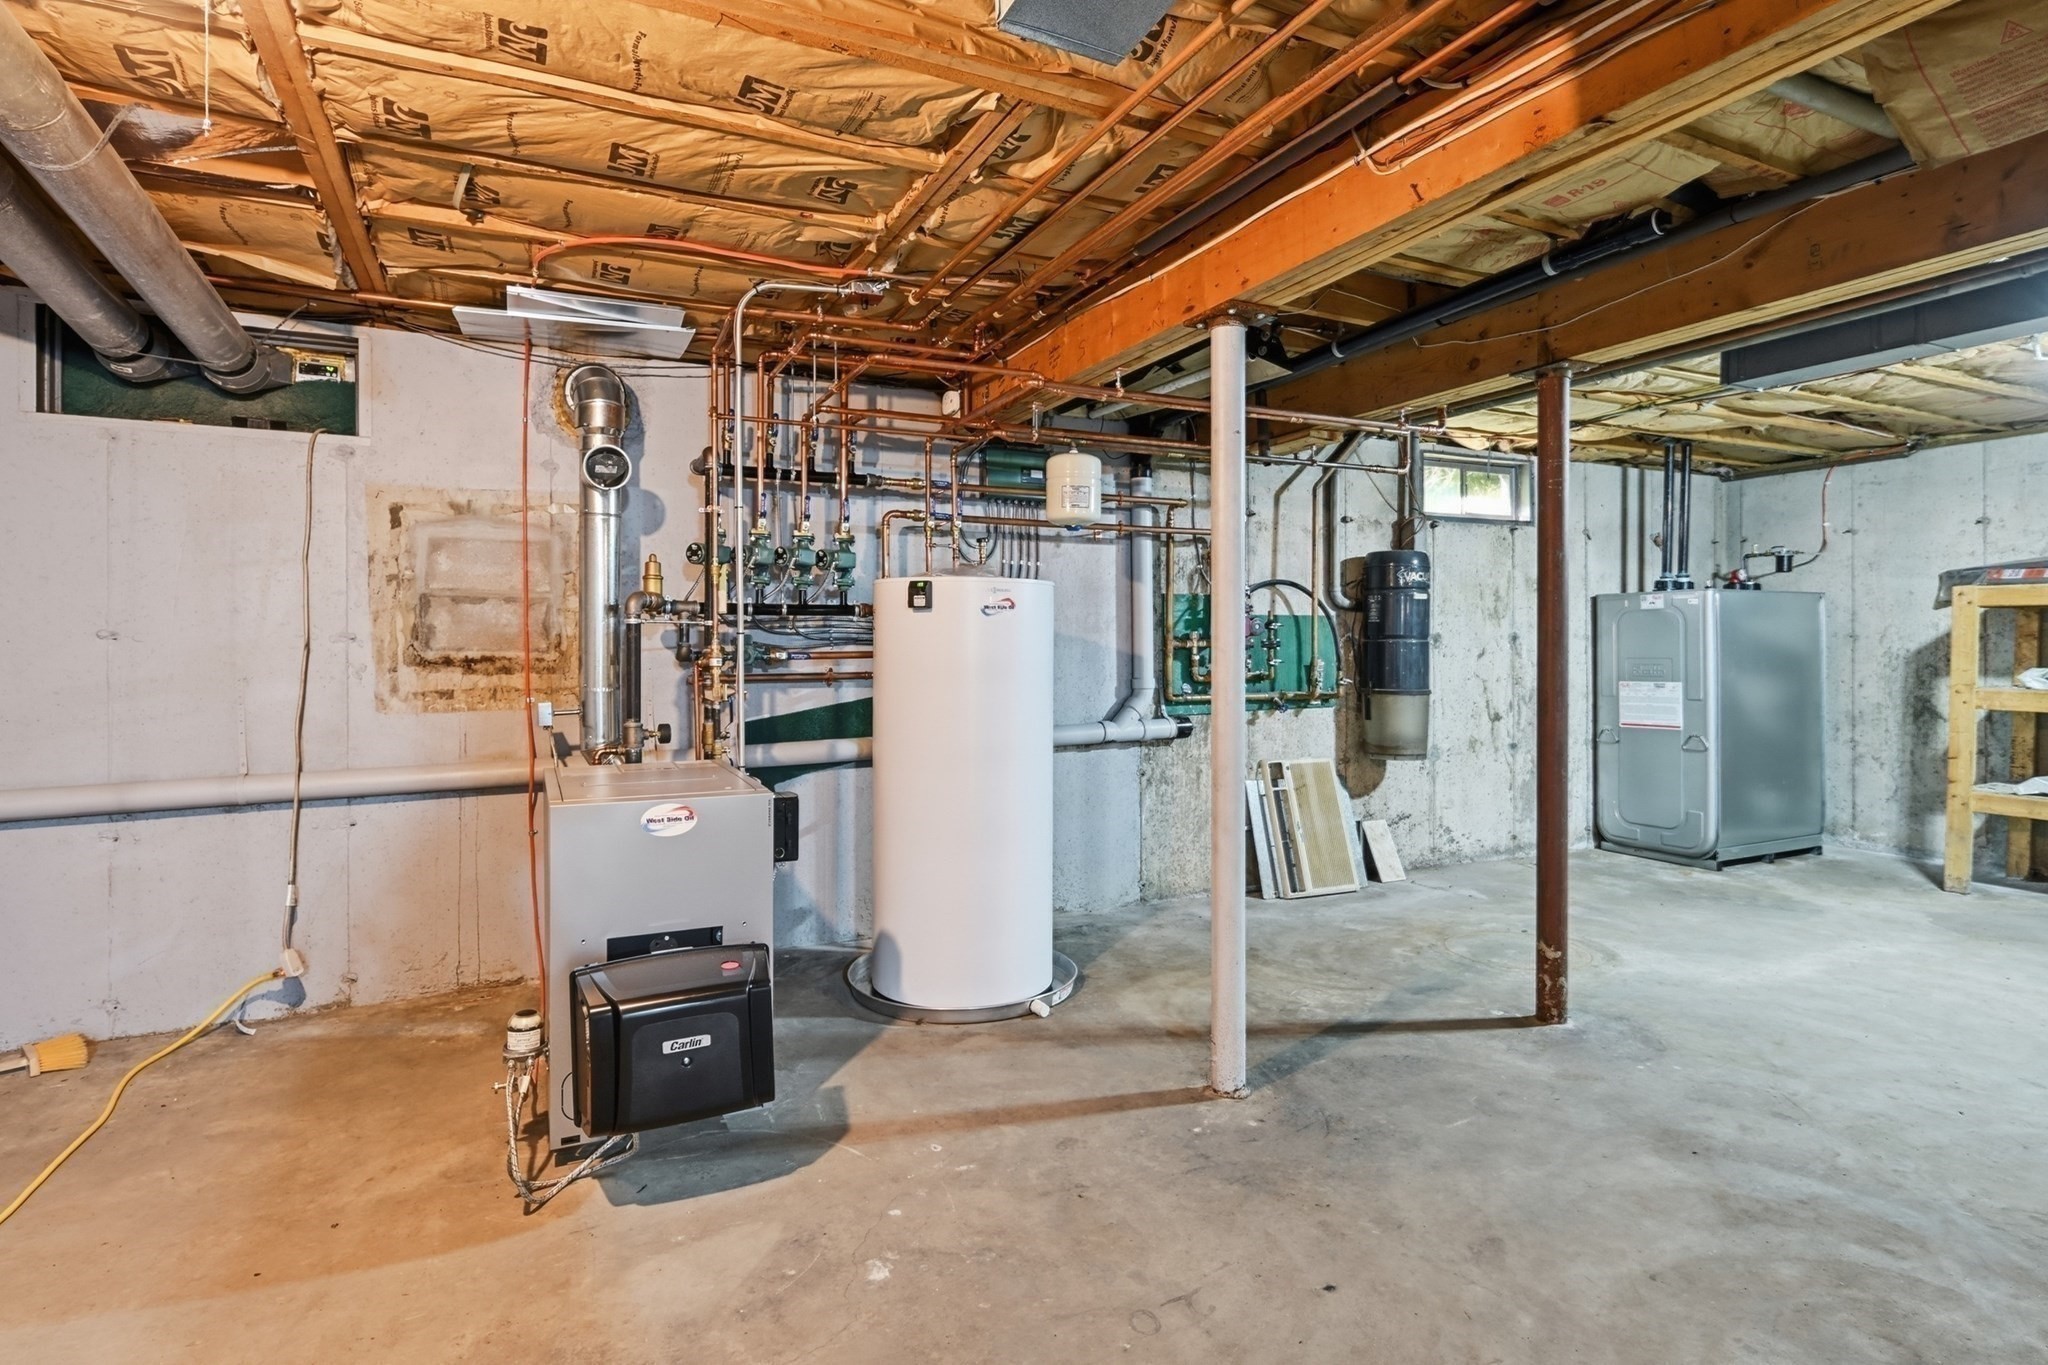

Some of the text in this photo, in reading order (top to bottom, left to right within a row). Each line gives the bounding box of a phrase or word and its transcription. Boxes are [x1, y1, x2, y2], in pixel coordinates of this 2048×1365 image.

[498, 18, 548, 65] JM
[734, 74, 786, 115] JM
[382, 97, 432, 140] JM
[606, 142, 650, 178] JM
[815, 176, 858, 205] JM
[1567, 178, 1608, 198] R-19
[600, 262, 632, 286] JM
[670, 1037, 702, 1051] Carlin
